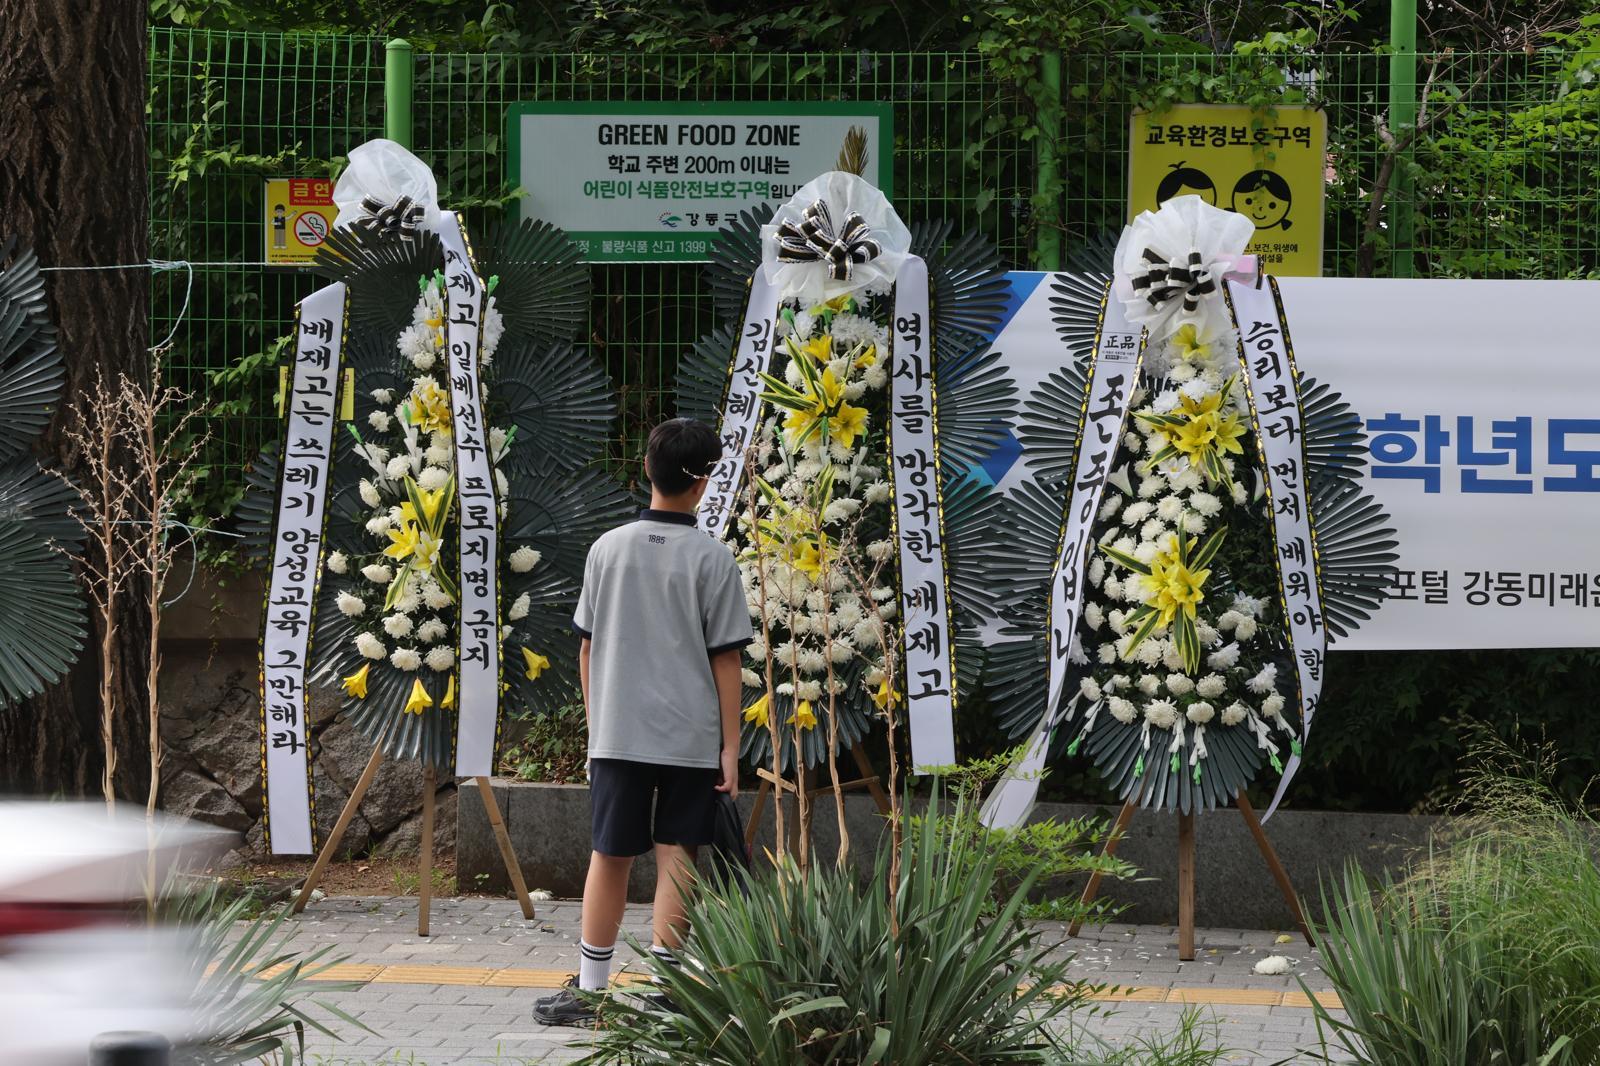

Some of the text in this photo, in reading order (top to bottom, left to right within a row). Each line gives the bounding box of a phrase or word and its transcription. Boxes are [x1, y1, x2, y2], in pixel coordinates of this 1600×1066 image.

[598, 124, 800, 146] GREEN FOOD ZONE
[1145, 125, 1311, 148] 교육환경보호구역
[608, 155, 790, 174] 학교 주변 200m 이내는
[583, 180, 803, 200] 어린이 식품안전보호구역입니
[568, 240, 590, 254] 정
[602, 240, 648, 254] 불량식품
[651, 240, 675, 254] 신고
[679, 241, 706, 253] 1399
[1104, 335, 1135, 349] 正品
[1245, 321, 1300, 444] 승리보다
[1311, 413, 1600, 494] 학년도
[893, 313, 949, 700] 역사를 망각한 배재고
[1271, 458, 1300, 523] 먼저
[267, 318, 333, 755] 배재고는 쓰레기 양성교육 그만해라
[461, 476, 494, 598] 프로지명
[648, 534, 666, 545] 1885
[1279, 537, 1322, 635] 배워야
[462, 609, 494, 670] 금지
[1299, 648, 1323, 681] 할
